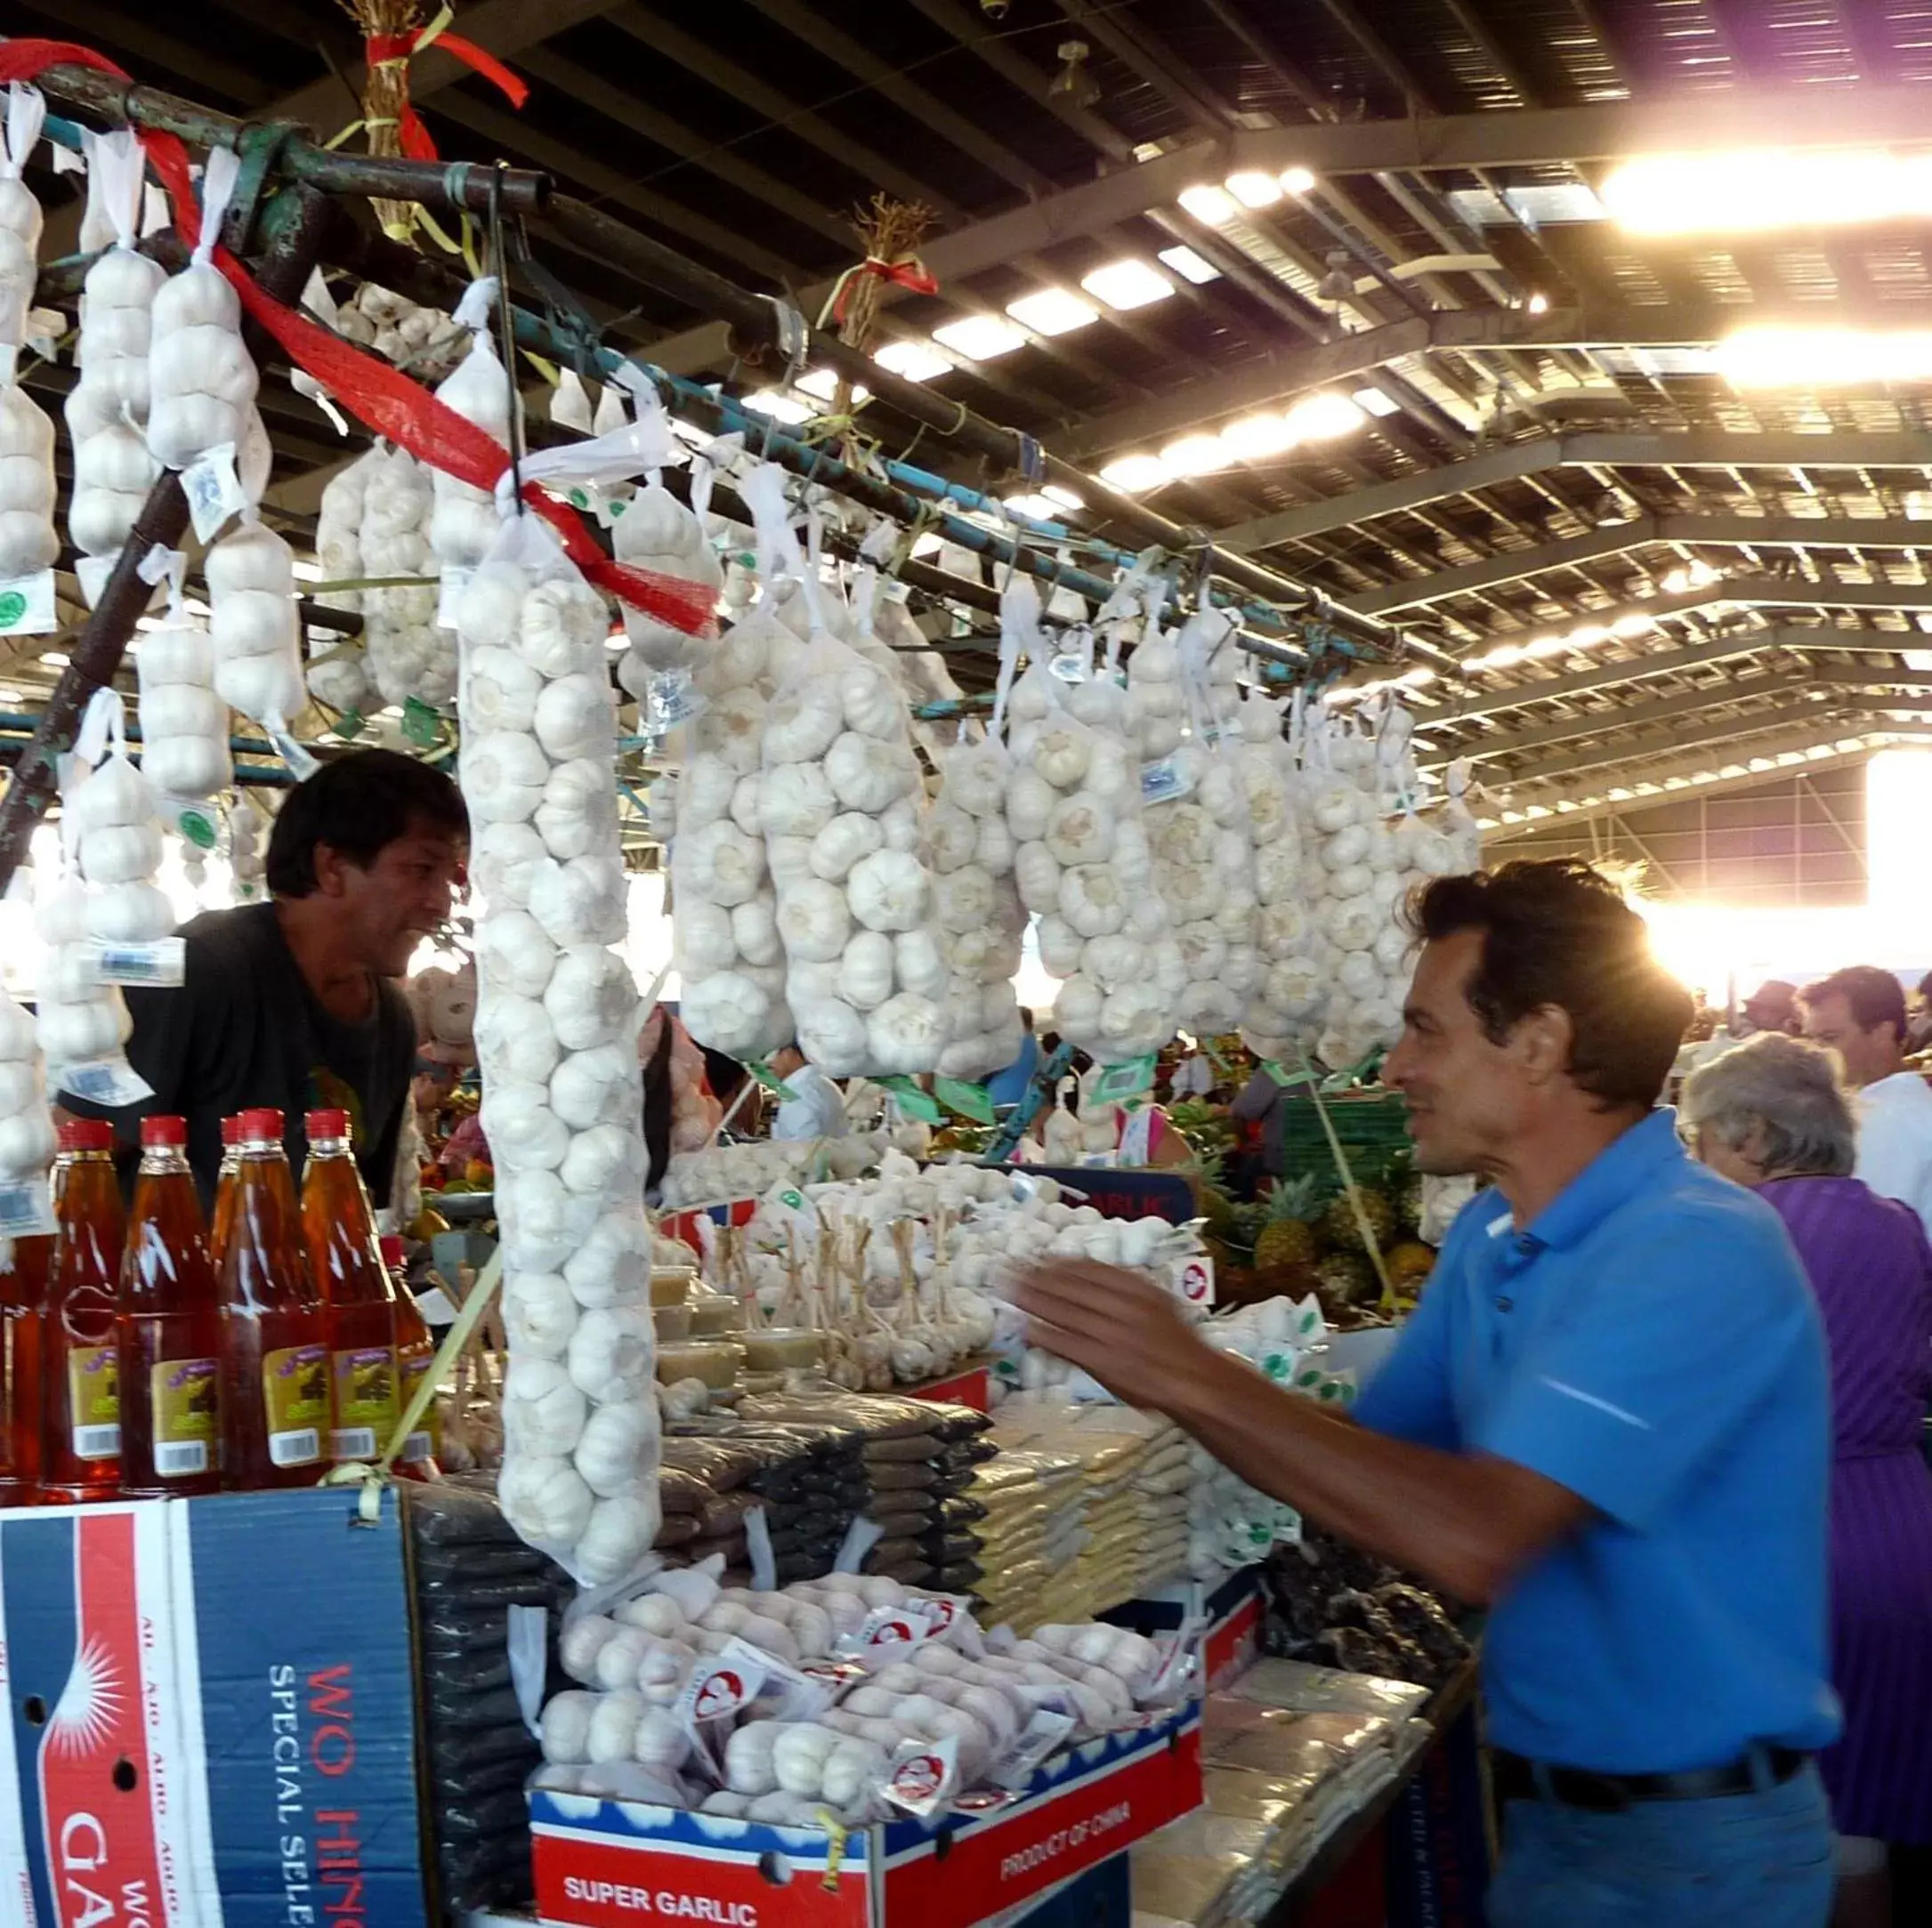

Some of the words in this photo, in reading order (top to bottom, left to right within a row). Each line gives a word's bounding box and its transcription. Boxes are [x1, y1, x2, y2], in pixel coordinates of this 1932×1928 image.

[269, 1665, 303, 1824] SPECIAL
[308, 1663, 354, 1778] WO
[280, 1834, 315, 1928] SELE
[316, 1809, 367, 1928] HIN
[1000, 1830, 1068, 1882] PRODUCT
[1069, 1819, 1091, 1847] OF
[1089, 1801, 1132, 1836] CHINA
[563, 1876, 651, 1911] SUPER
[655, 1891, 758, 1928] GARLIC
